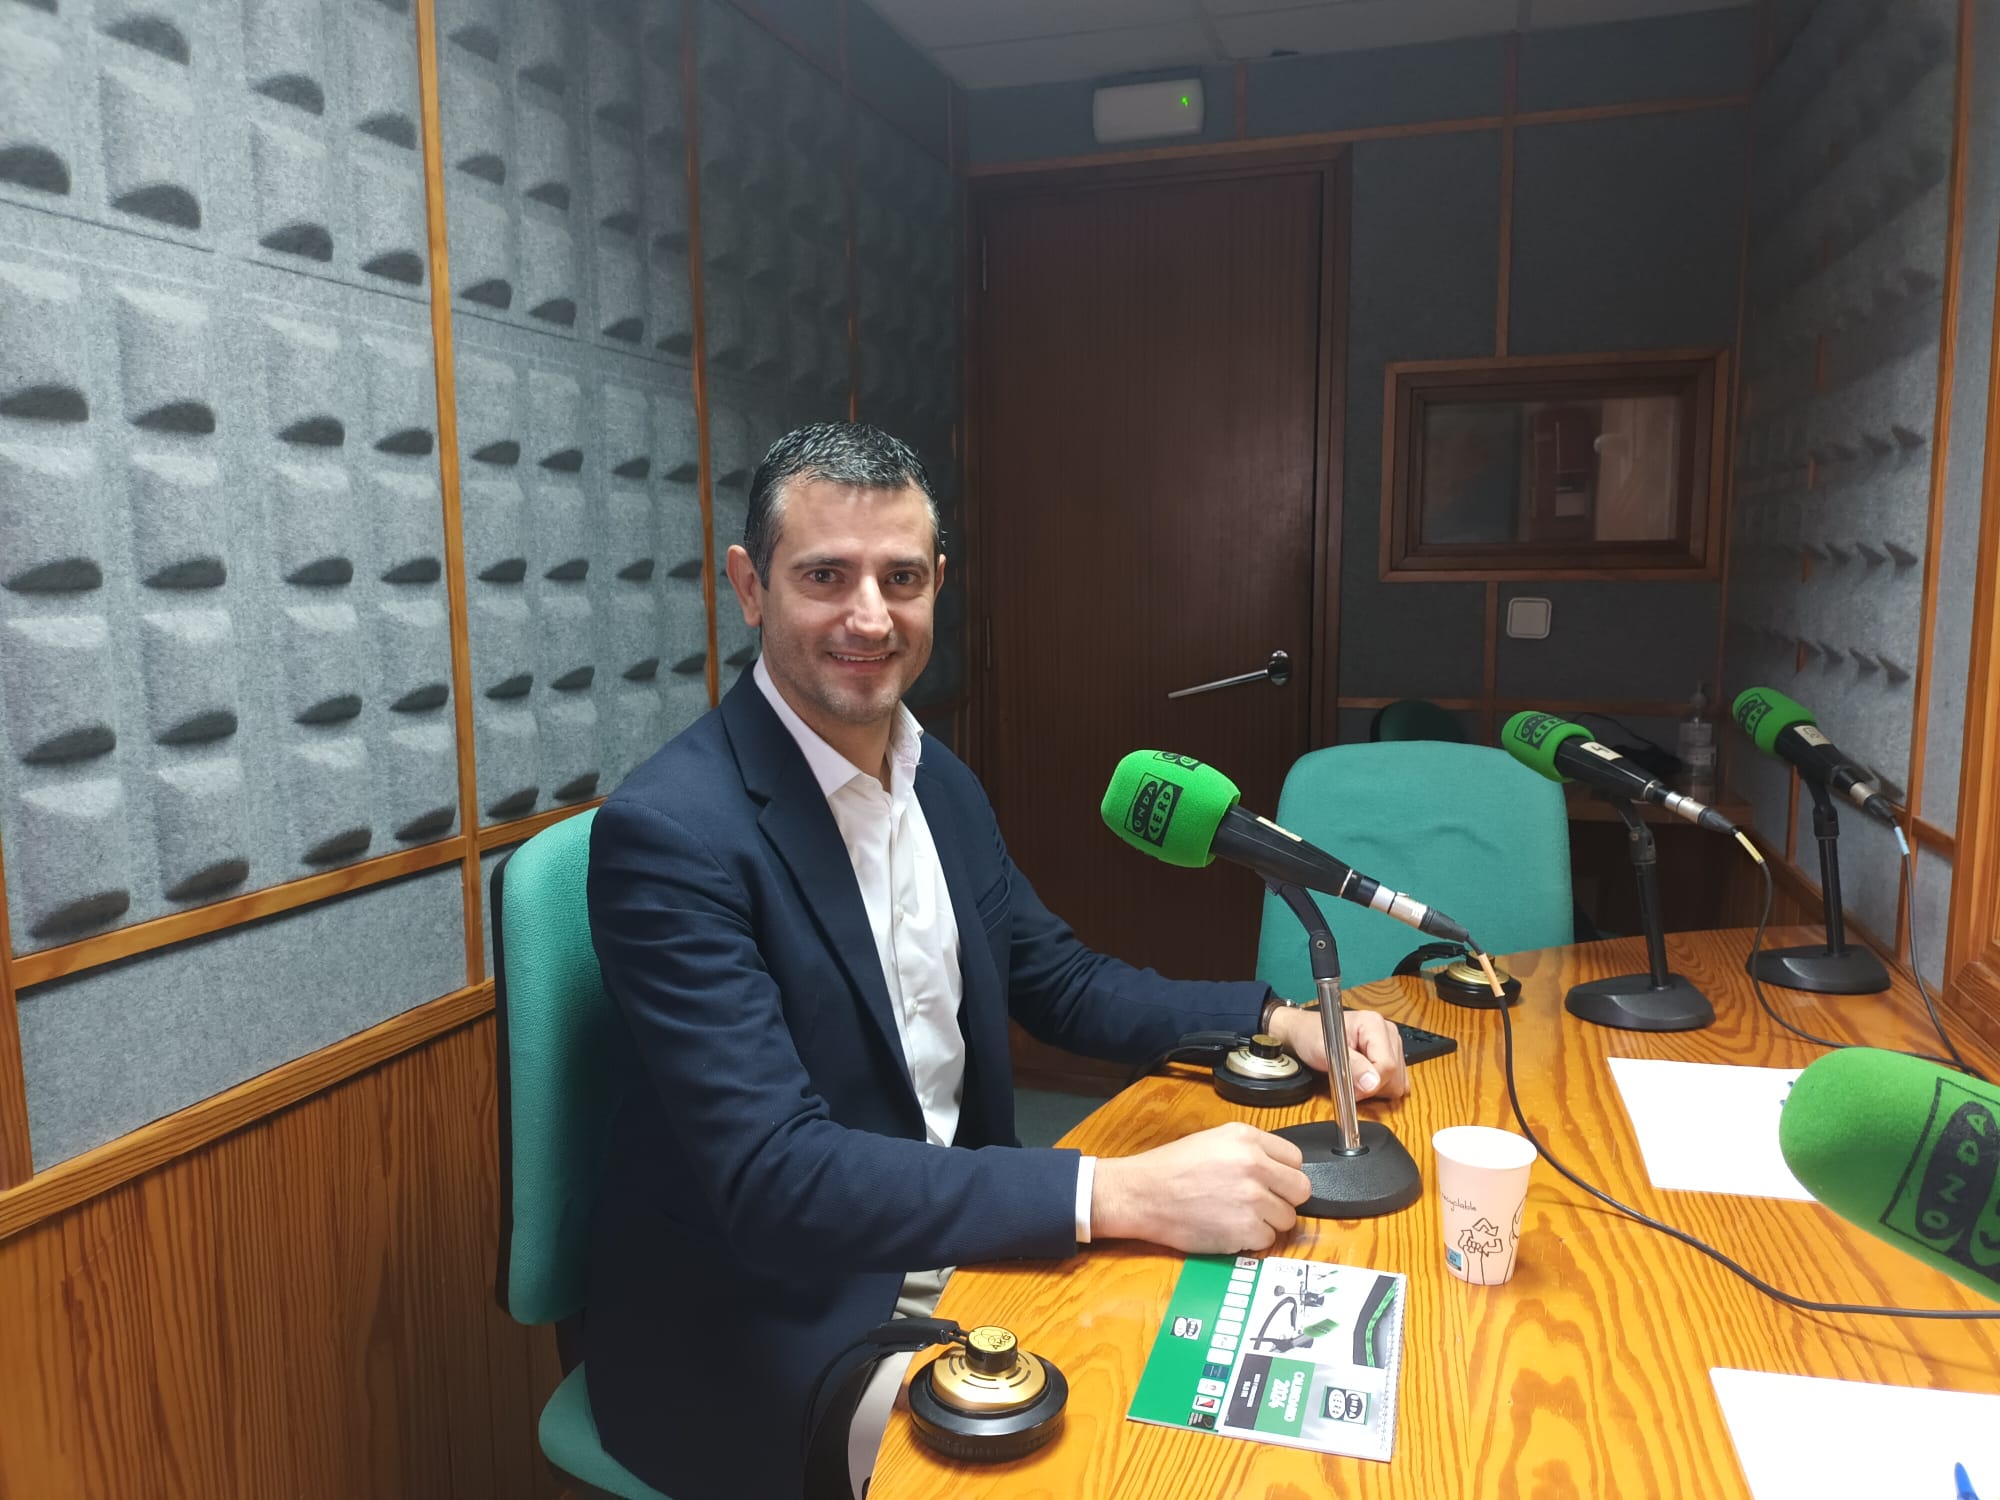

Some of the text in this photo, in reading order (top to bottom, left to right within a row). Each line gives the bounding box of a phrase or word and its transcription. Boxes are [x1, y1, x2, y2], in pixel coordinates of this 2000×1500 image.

[1133, 786, 1155, 828] ONDA
[1149, 791, 1171, 833] CERO
[1922, 1113, 1987, 1231] ONDA
[991, 1334, 1011, 1350] AKG
